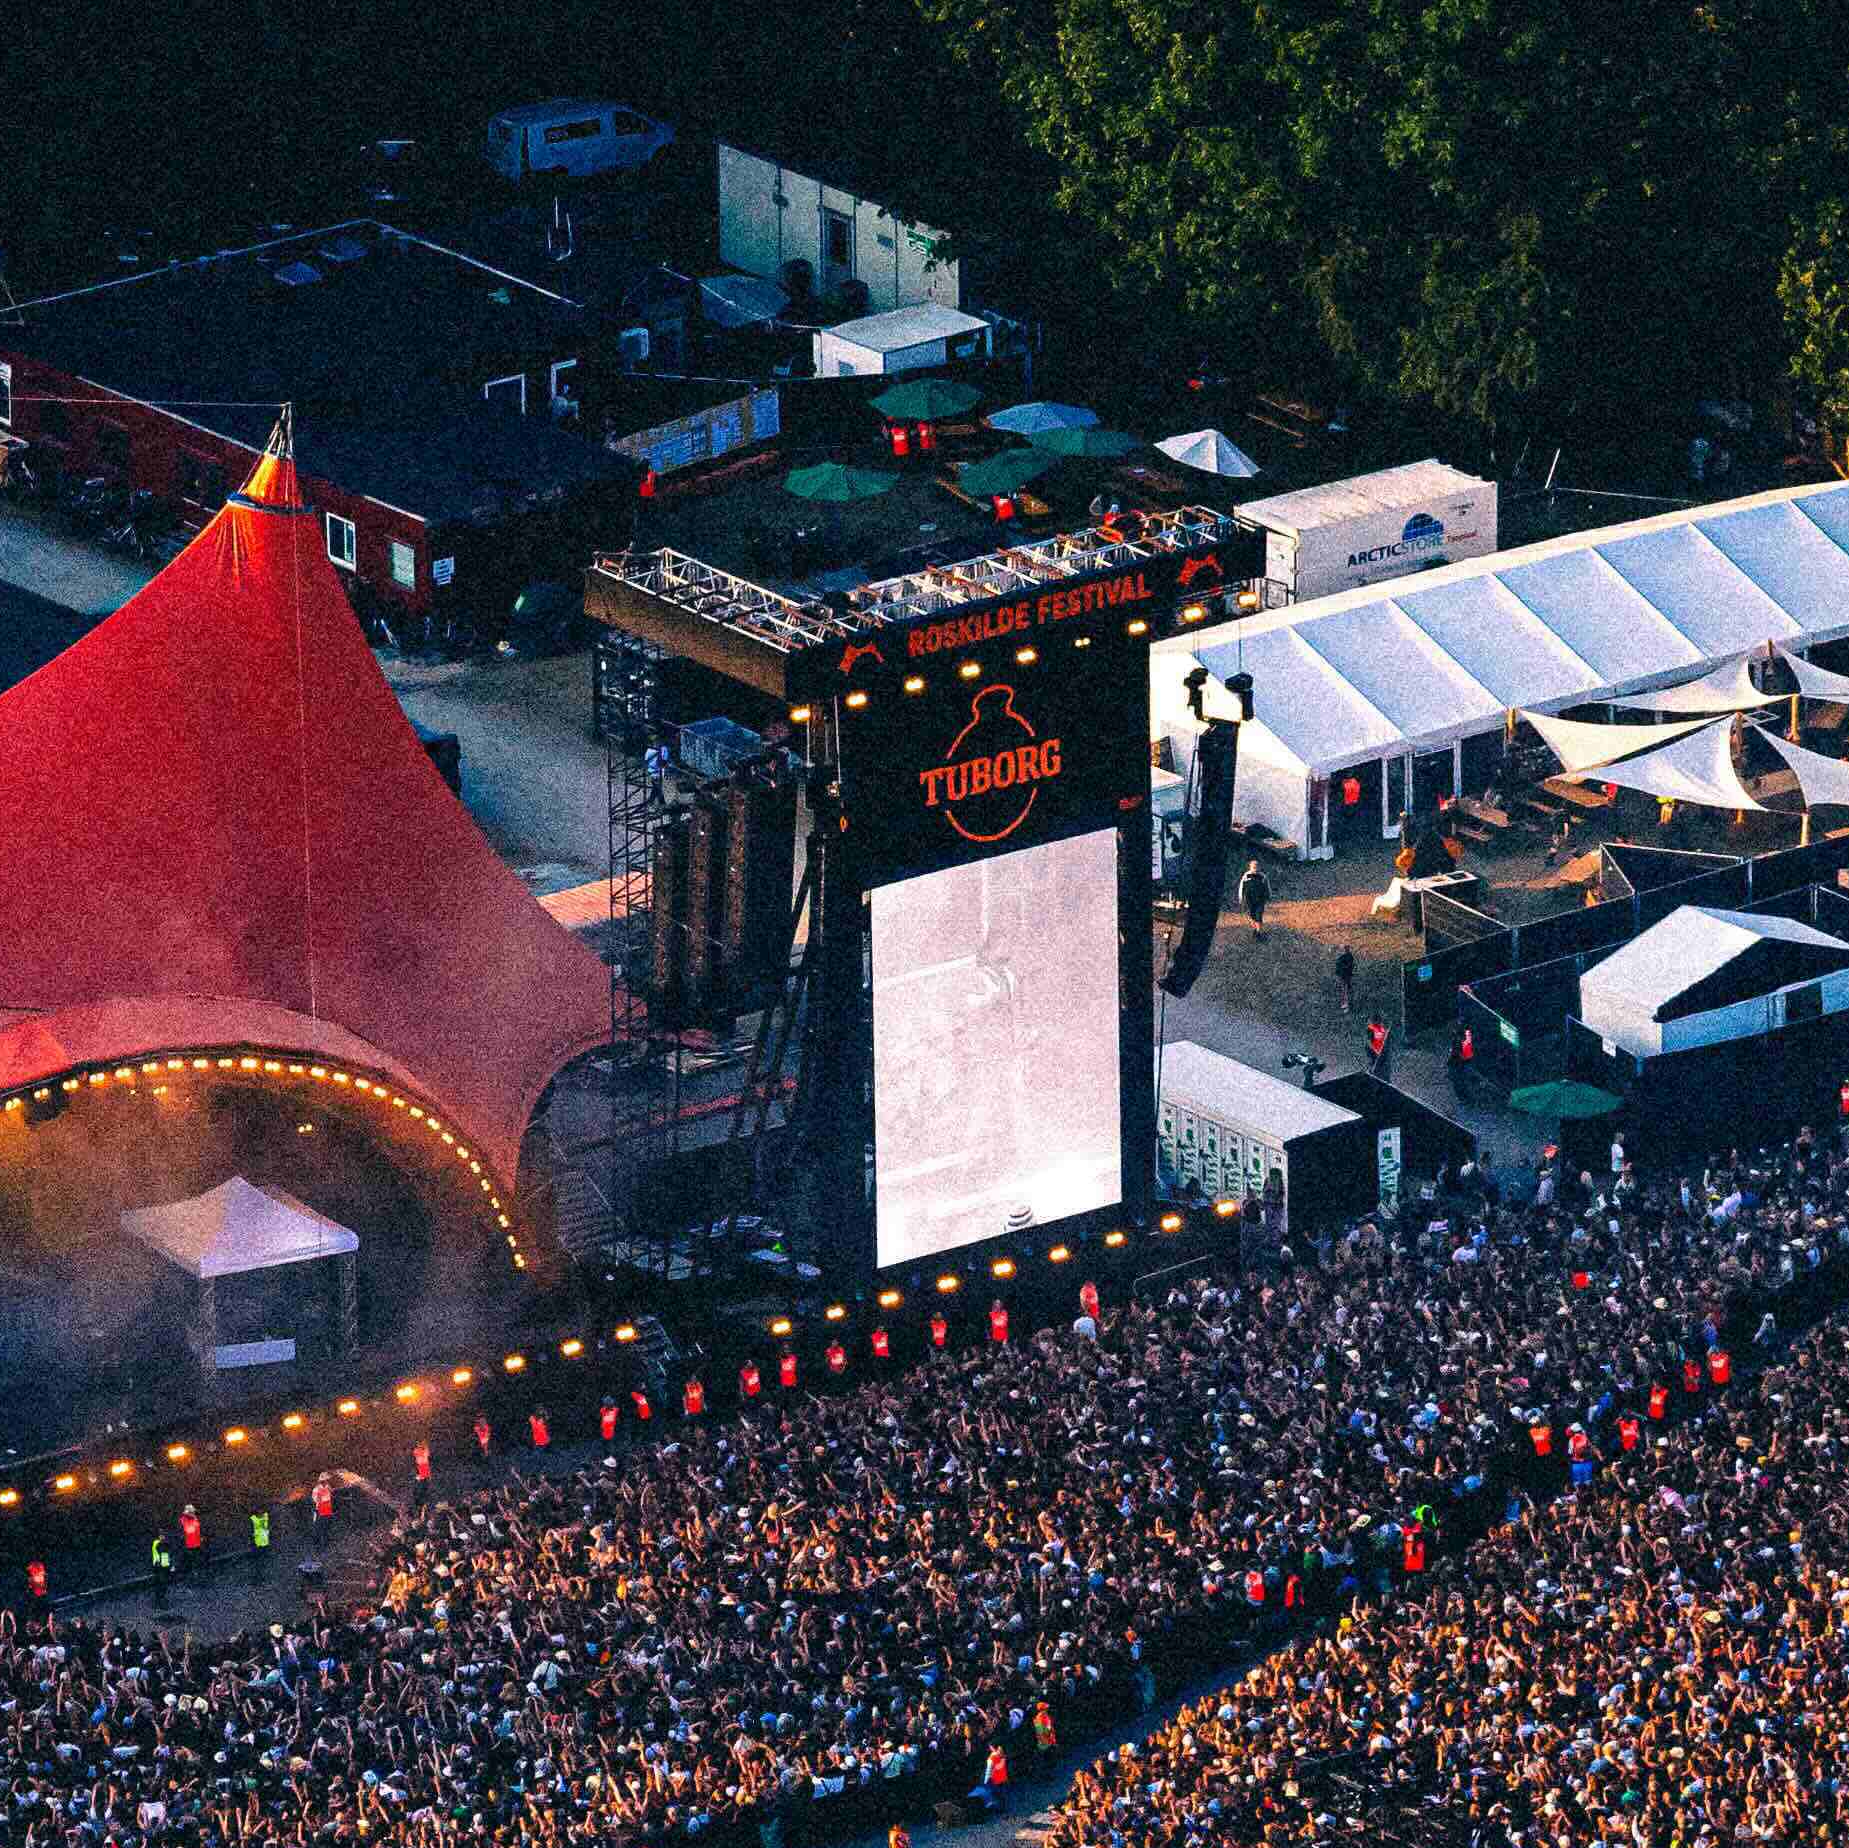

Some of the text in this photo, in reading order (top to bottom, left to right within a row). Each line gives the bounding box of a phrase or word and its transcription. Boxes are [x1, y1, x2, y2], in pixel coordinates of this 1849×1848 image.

[907, 571, 1155, 657] ROSKILDE FESTIVAL
[919, 737, 1062, 808] TUBORG
